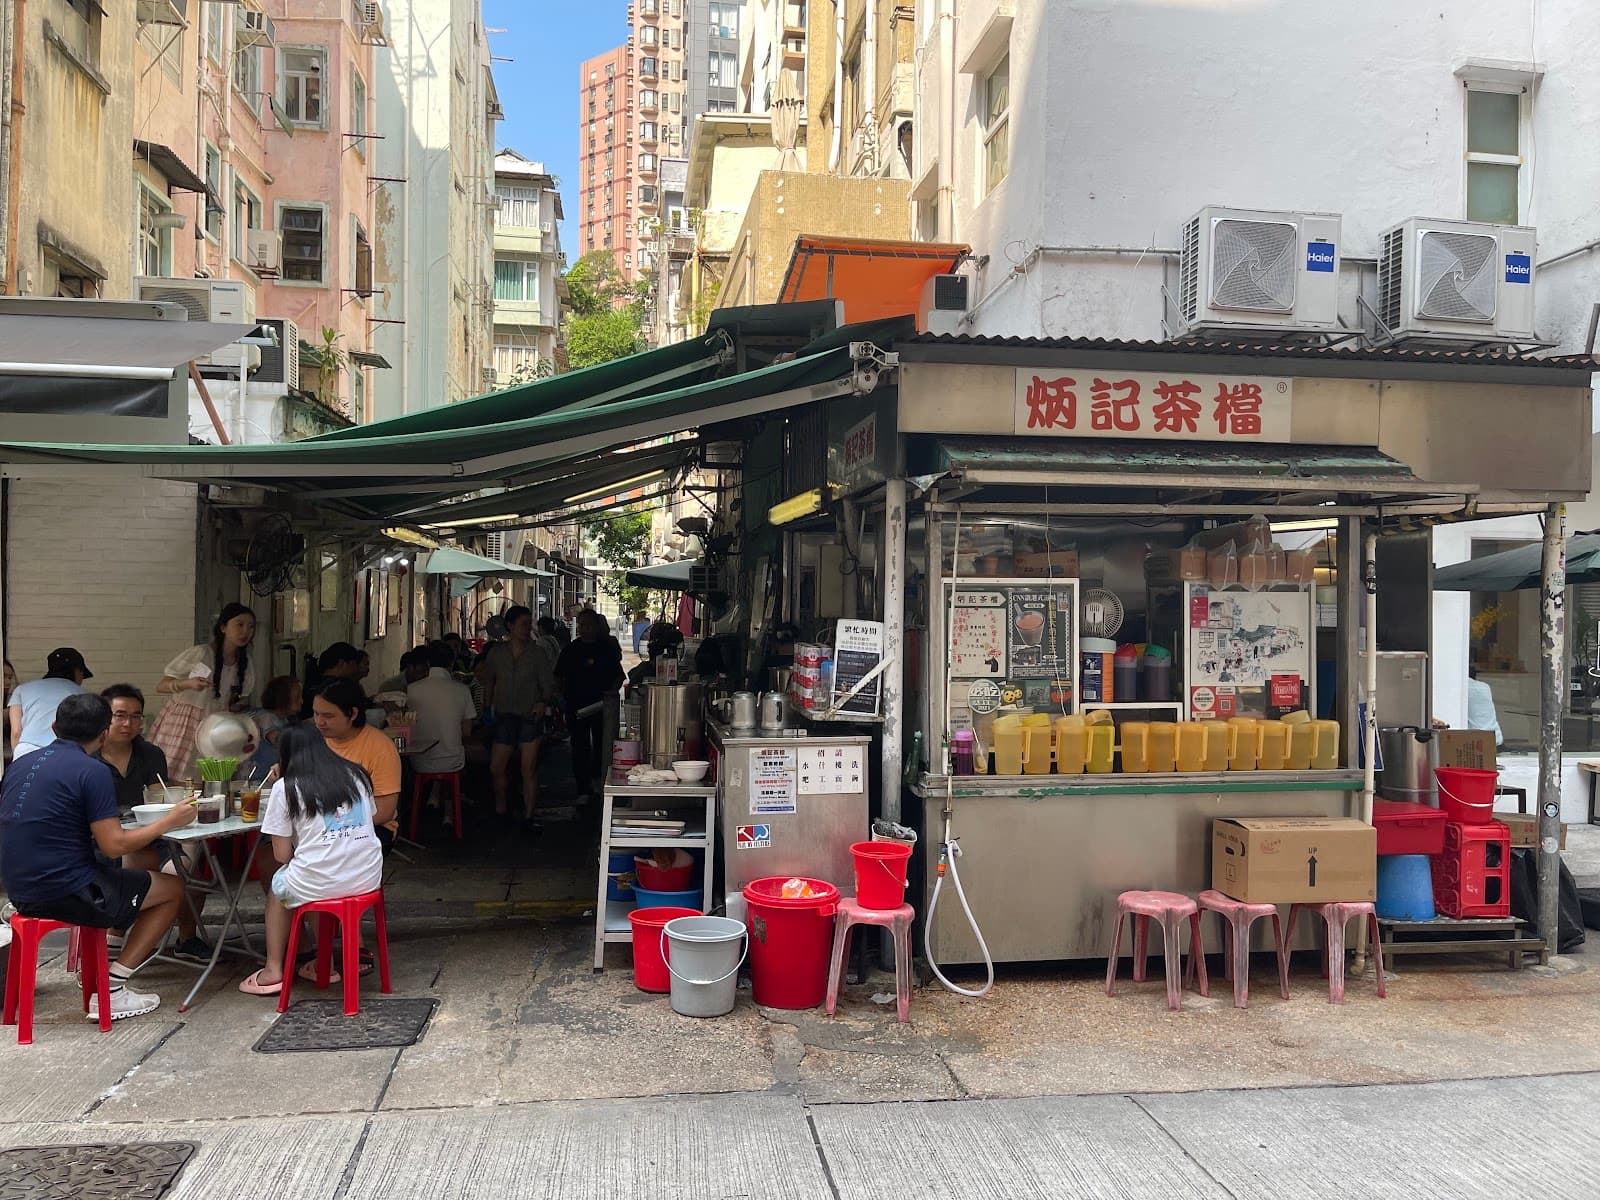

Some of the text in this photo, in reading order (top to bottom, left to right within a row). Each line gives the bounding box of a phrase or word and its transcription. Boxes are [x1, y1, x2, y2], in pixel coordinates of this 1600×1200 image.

[1307, 252, 1334, 263] Haier
[1506, 264, 1530, 275] Haier
[1026, 376, 1263, 435] 炳記茶檔
[12, 750, 56, 818] DESCENTE
[1308, 847, 1318, 855] UP
